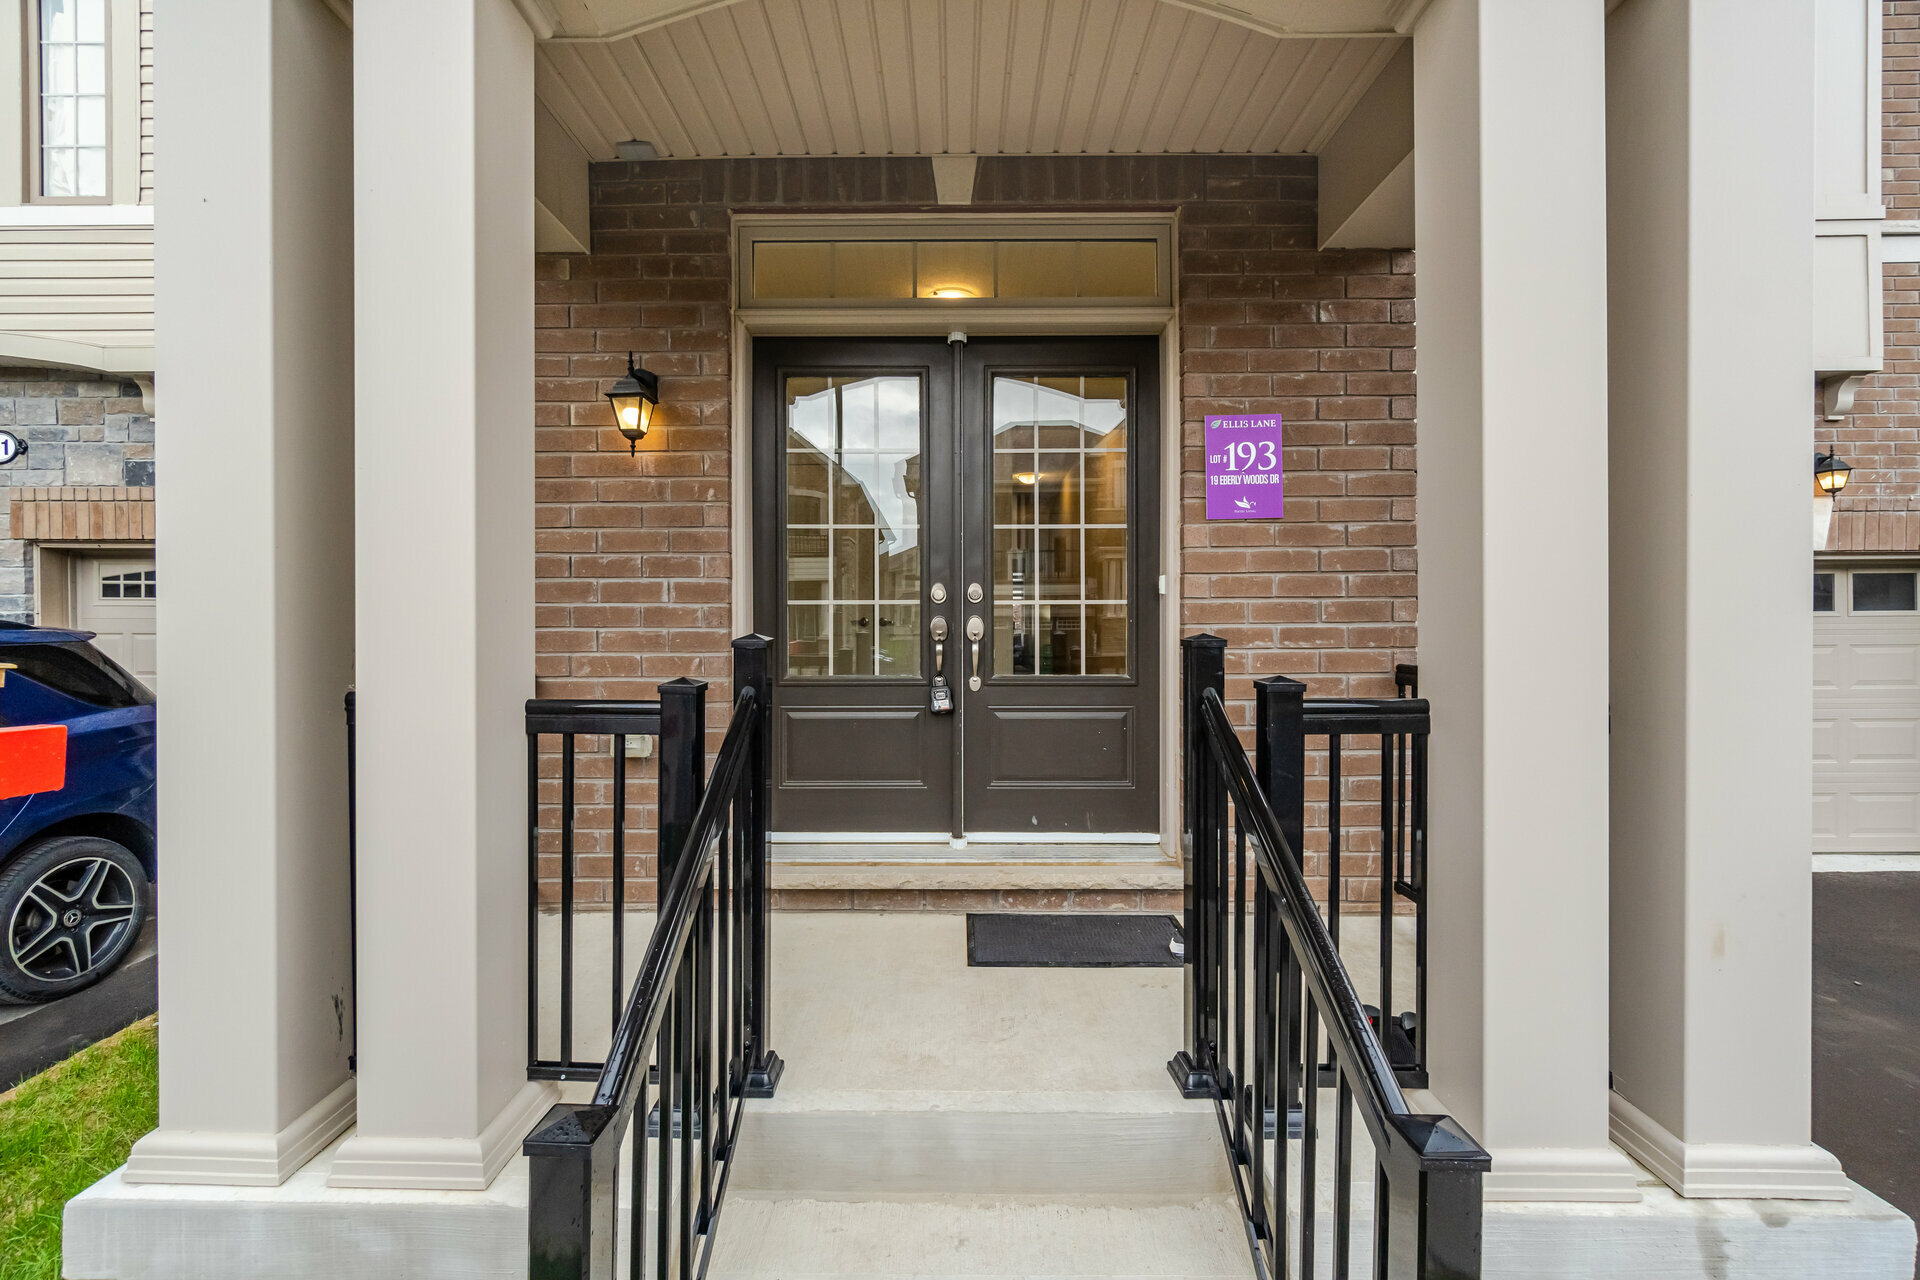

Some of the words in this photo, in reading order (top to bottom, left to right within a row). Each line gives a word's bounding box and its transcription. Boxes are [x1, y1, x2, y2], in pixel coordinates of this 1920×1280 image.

[1223, 420, 1249, 429] ELLIS
[1251, 419, 1276, 428] LANE
[1209, 454, 1221, 464] LOT
[1210, 475, 1219, 485] 19
[1219, 474, 1242, 485] EBERLY
[1242, 473, 1268, 485] WOODS
[1269, 473, 1280, 484] DR
